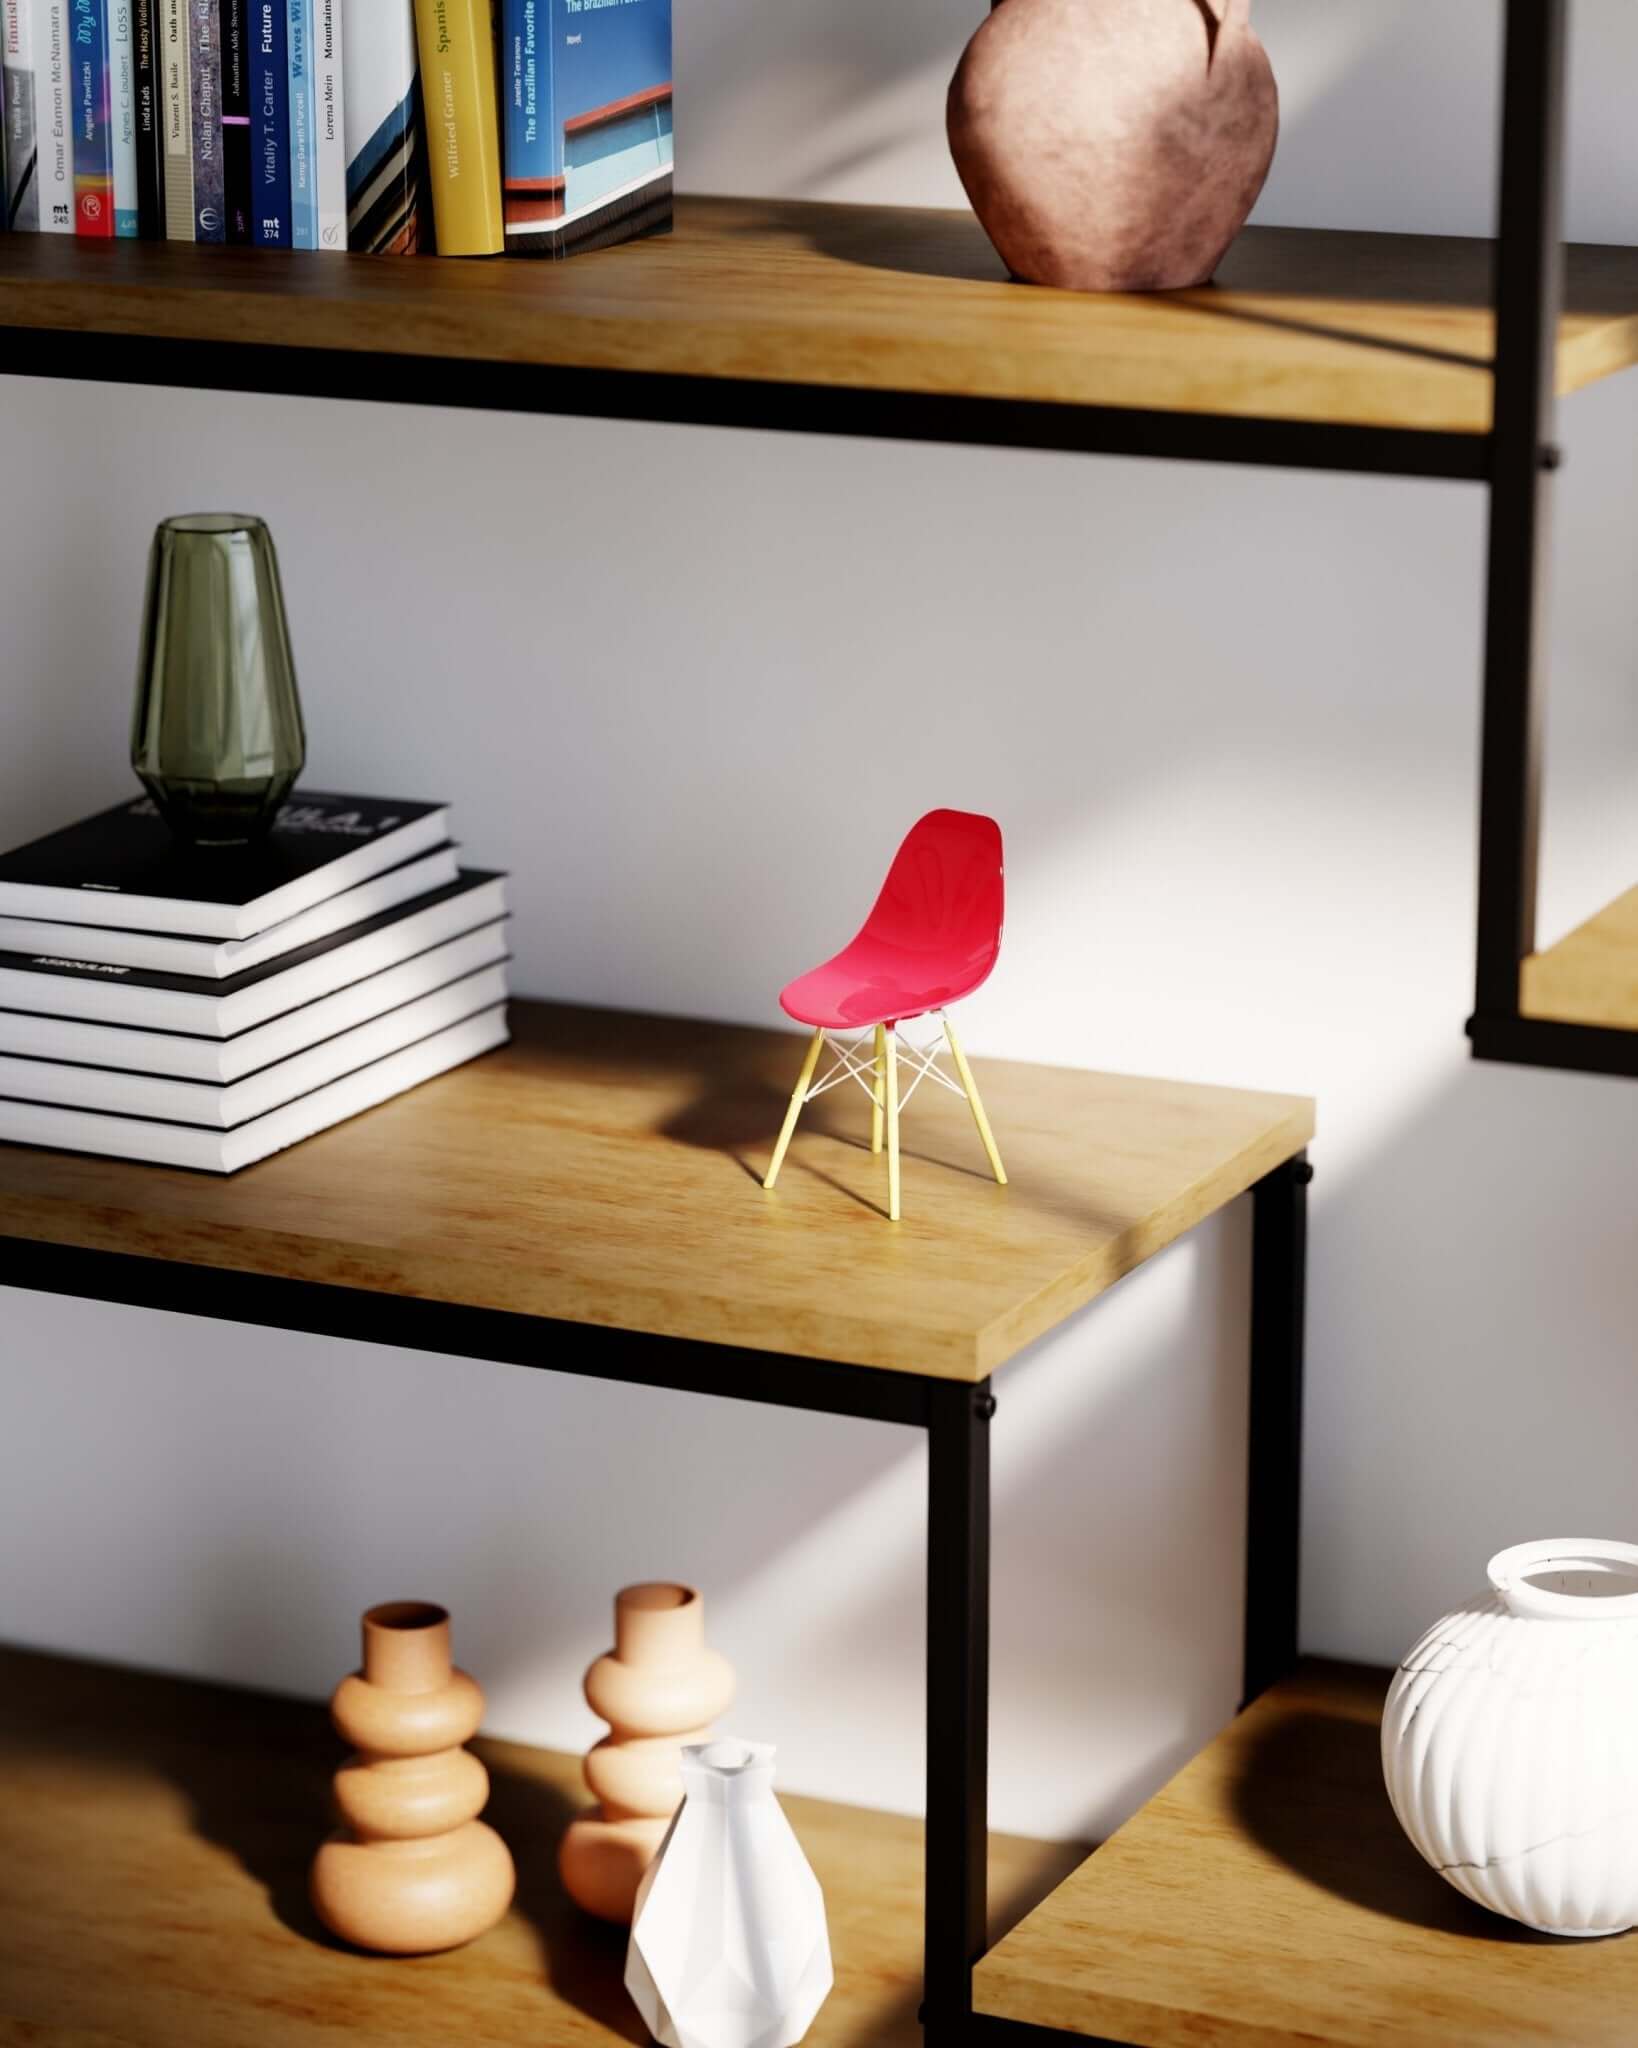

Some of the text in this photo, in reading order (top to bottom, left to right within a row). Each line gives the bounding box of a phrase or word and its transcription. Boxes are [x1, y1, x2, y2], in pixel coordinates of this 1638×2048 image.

[51, 6, 62, 82] McNamara
[139, 28, 150, 52] Hasty
[169, 18, 177, 42] Oath
[199, 24, 209, 53] The
[261, 4, 272, 53] Future
[140, 53, 149, 69] The
[292, 27, 303, 79] Waves
[524, 0, 536, 143] The Brazilian Favorite
[141, 86, 151, 131] Linda Eads
[199, 67, 213, 160] Nolan Chaput
[264, 70, 274, 116] Carter
[324, 75, 335, 140] Lorena Mein
[86, 107, 95, 142] Angela
[55, 143, 65, 181] Omar
[264, 138, 278, 184] Vitaliy
[445, 121, 460, 178] Wilfried
[53, 204, 69, 214] mt
[263, 217, 279, 229] mt
[264, 229, 279, 239] 374
